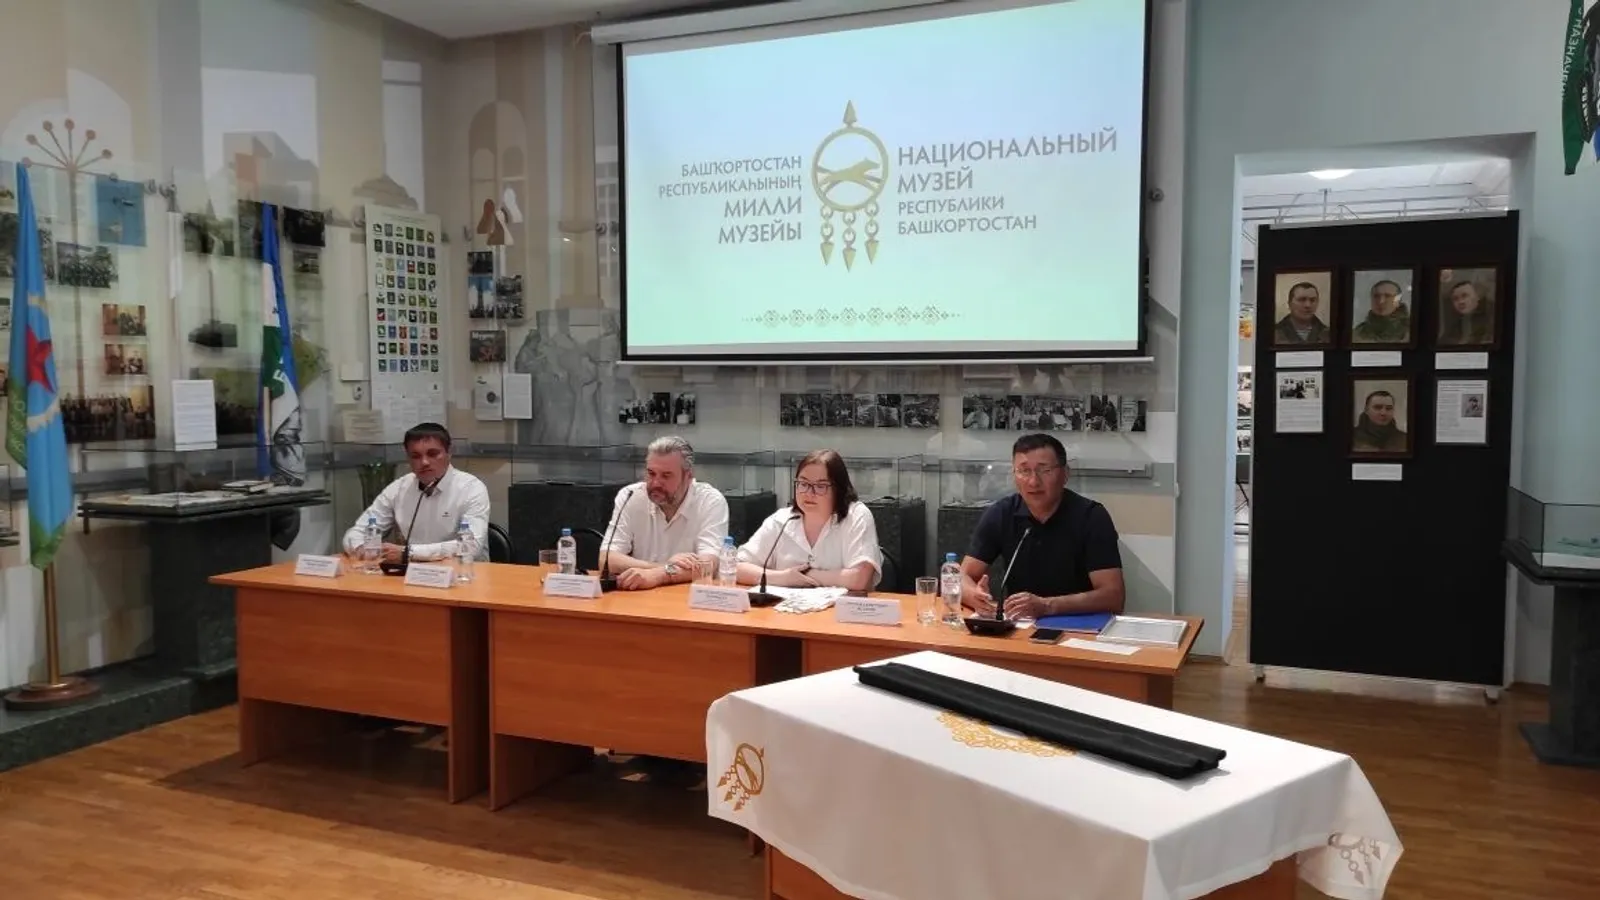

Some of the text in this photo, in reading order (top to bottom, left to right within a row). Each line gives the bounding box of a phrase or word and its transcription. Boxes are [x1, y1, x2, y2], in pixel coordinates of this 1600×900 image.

[898, 126, 1118, 167] НАЦИОНАЛЬНЫЙ
[897, 165, 974, 194] МУЗЕЙ
[723, 195, 802, 218] МИЛЛИ
[898, 195, 1005, 217] РЕСПУБЛИКИ
[717, 218, 802, 245] МУЗЕЙЫ
[898, 215, 1037, 235] БАШКОРТОСТАН
